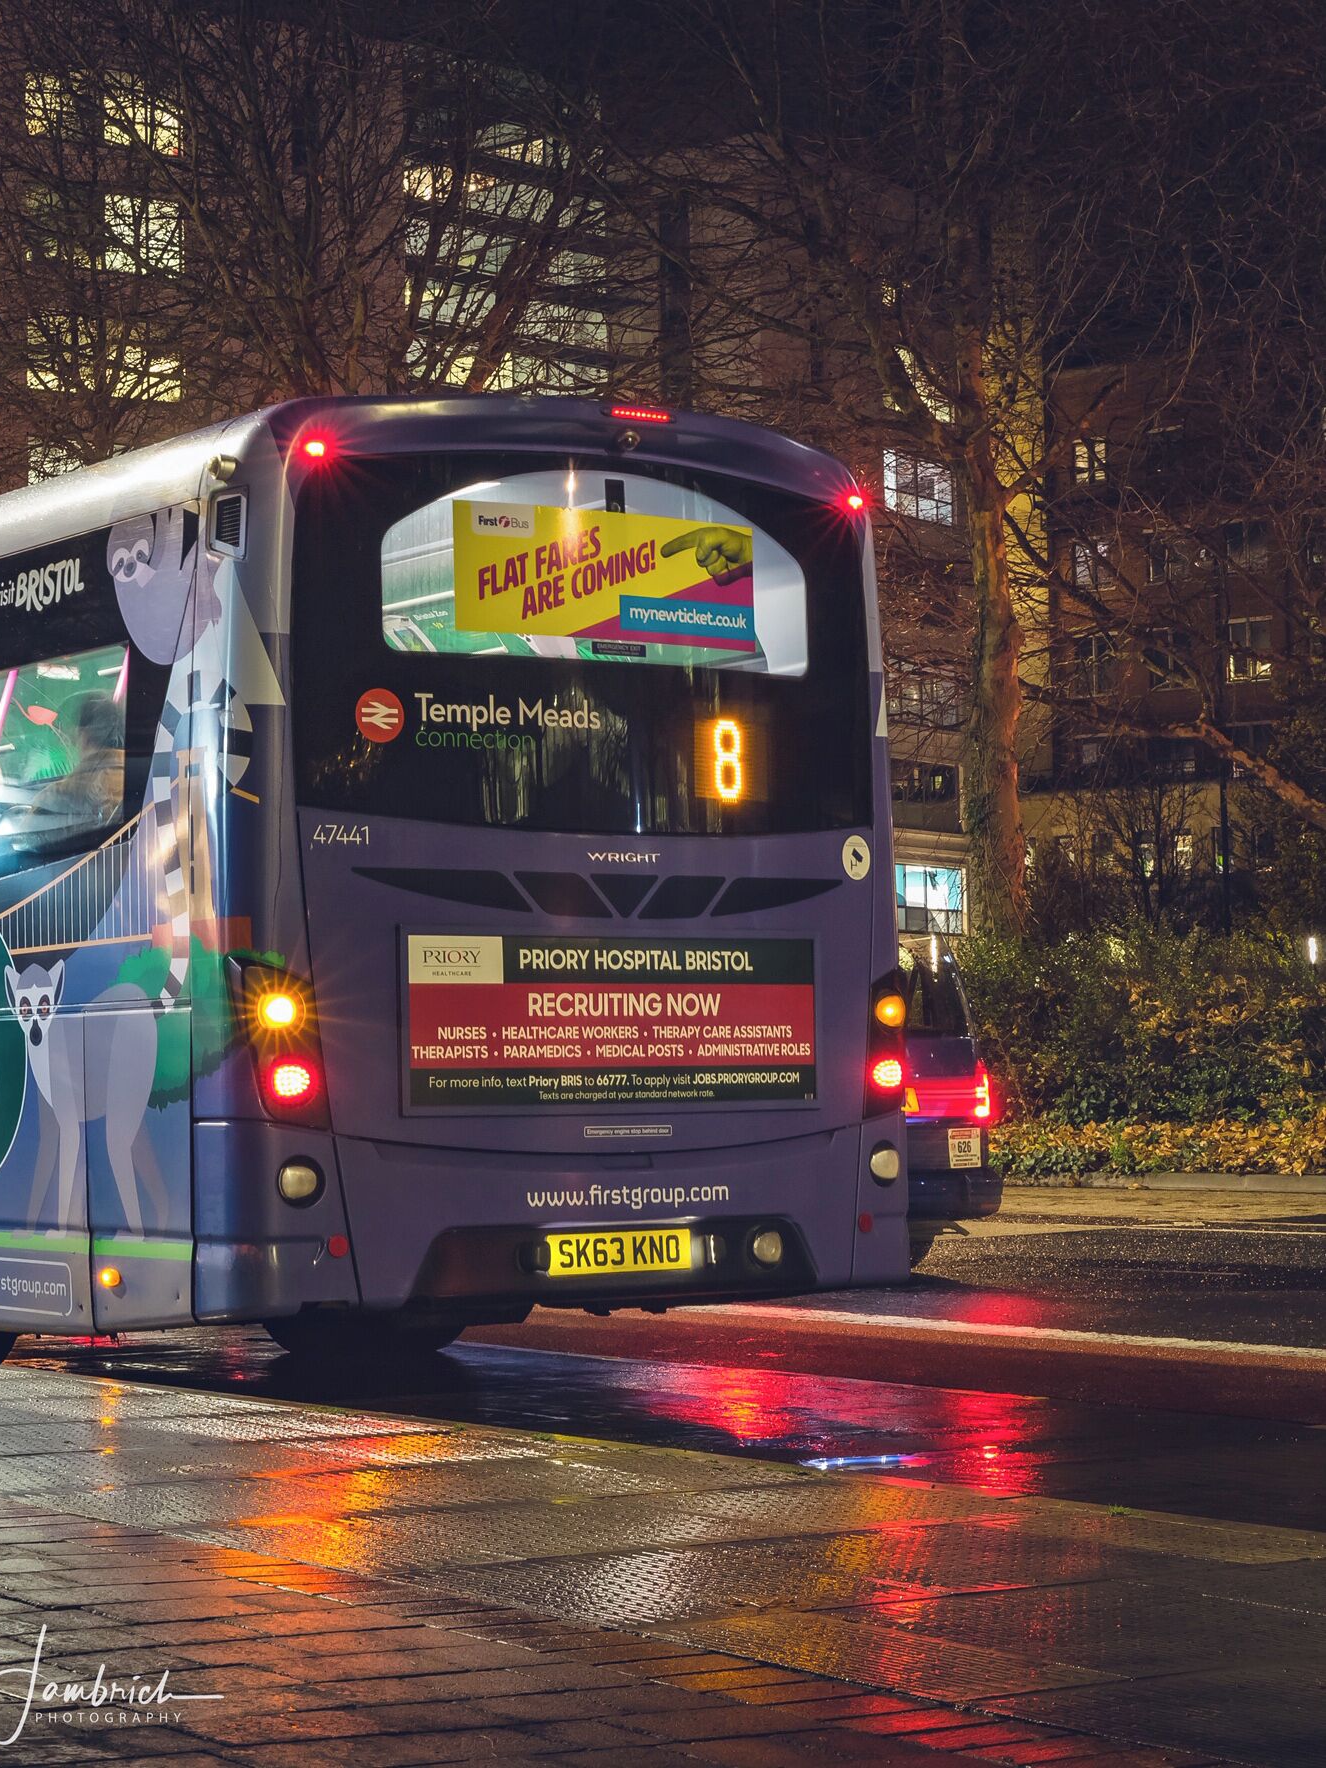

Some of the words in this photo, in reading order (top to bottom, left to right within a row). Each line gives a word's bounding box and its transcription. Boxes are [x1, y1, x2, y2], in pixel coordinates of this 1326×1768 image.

[478, 515, 497, 528] First
[510, 517, 529, 529] Bus
[478, 552, 528, 600] FLAT
[535, 526, 601, 580] FARES
[15, 558, 84, 612] BRISTOL
[522, 574, 565, 620] ARE
[572, 540, 656, 599] COMING!
[629, 604, 747, 630] mynewticket.co.uk
[414, 692, 511, 731] Temple
[518, 694, 601, 729] Meads
[415, 728, 534, 751] connection
[713, 719, 742, 802] 8
[312, 824, 370, 845] 47441
[587, 852, 660, 864] WRIGHT
[422, 949, 481, 965] PRIORY
[519, 948, 590, 970] PRIORY
[594, 949, 682, 971] HOSPITAL
[685, 950, 754, 972] BRISTOL
[528, 993, 663, 1017] RECRUITING
[666, 992, 721, 1017] NOW
[437, 1026, 487, 1040] NURSES
[502, 1026, 580, 1039] HEALTHCARE
[582, 1025, 639, 1039] WORKERS
[653, 1025, 701, 1039] THERAPY
[703, 1025, 732, 1038] CARE
[733, 1025, 793, 1038] ASSISTANTS
[411, 1045, 489, 1059] THERAPISTS
[503, 1045, 582, 1058] PARAMEDICS
[595, 1044, 646, 1057] MEDICAL
[648, 1044, 684, 1057] POSTS
[697, 1043, 780, 1056] ADMINISTRATIVE
[781, 1043, 811, 1056] ROLES
[429, 1076, 447, 1088] For
[450, 1078, 480, 1088] more
[481, 1076, 504, 1089] info,
[506, 1076, 527, 1087] text
[528, 1075, 559, 1089] Priory
[560, 1075, 582, 1087] BRIS
[584, 1076, 594, 1086] to
[596, 1074, 630, 1086] 66777.
[631, 1074, 642, 1086] To
[644, 1074, 670, 1088] apply
[673, 1073, 691, 1085] visit
[692, 1072, 800, 1085] JOBS.PRIORYGROUP.COM
[539, 1091, 559, 1100] Texts
[560, 1092, 574, 1100] are
[575, 1091, 608, 1101] charged
[609, 1091, 617, 1099] at
[618, 1092, 634, 1100] your
[635, 1090, 668, 1099] standard
[668, 1089, 698, 1098] network
[699, 1089, 715, 1098] rate.
[586, 1128, 613, 1136] Emergency
[957, 1141, 972, 1153] 626
[527, 1184, 729, 1210] www.firstgroup.com
[558, 1237, 626, 1269] SK63
[632, 1234, 680, 1265] KNO
